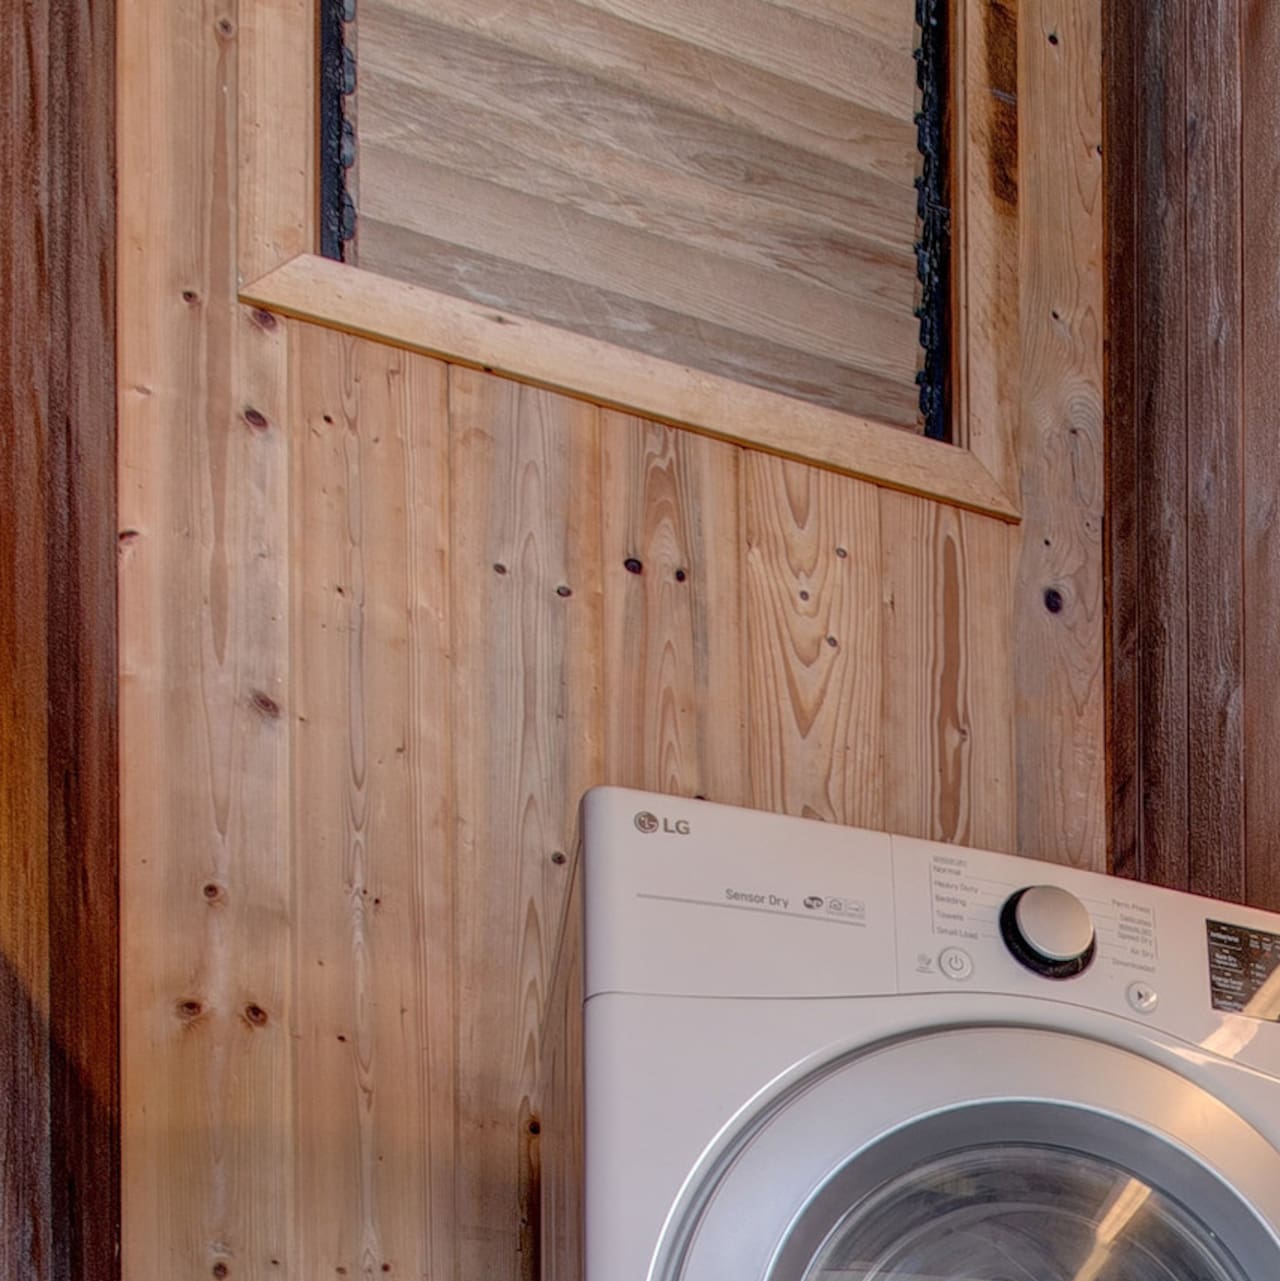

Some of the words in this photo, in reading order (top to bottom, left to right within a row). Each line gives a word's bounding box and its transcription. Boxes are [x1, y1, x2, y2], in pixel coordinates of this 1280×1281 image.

[663, 817, 690, 835] LG
[726, 888, 765, 904] Sensor
[768, 894, 789, 909] Dry
